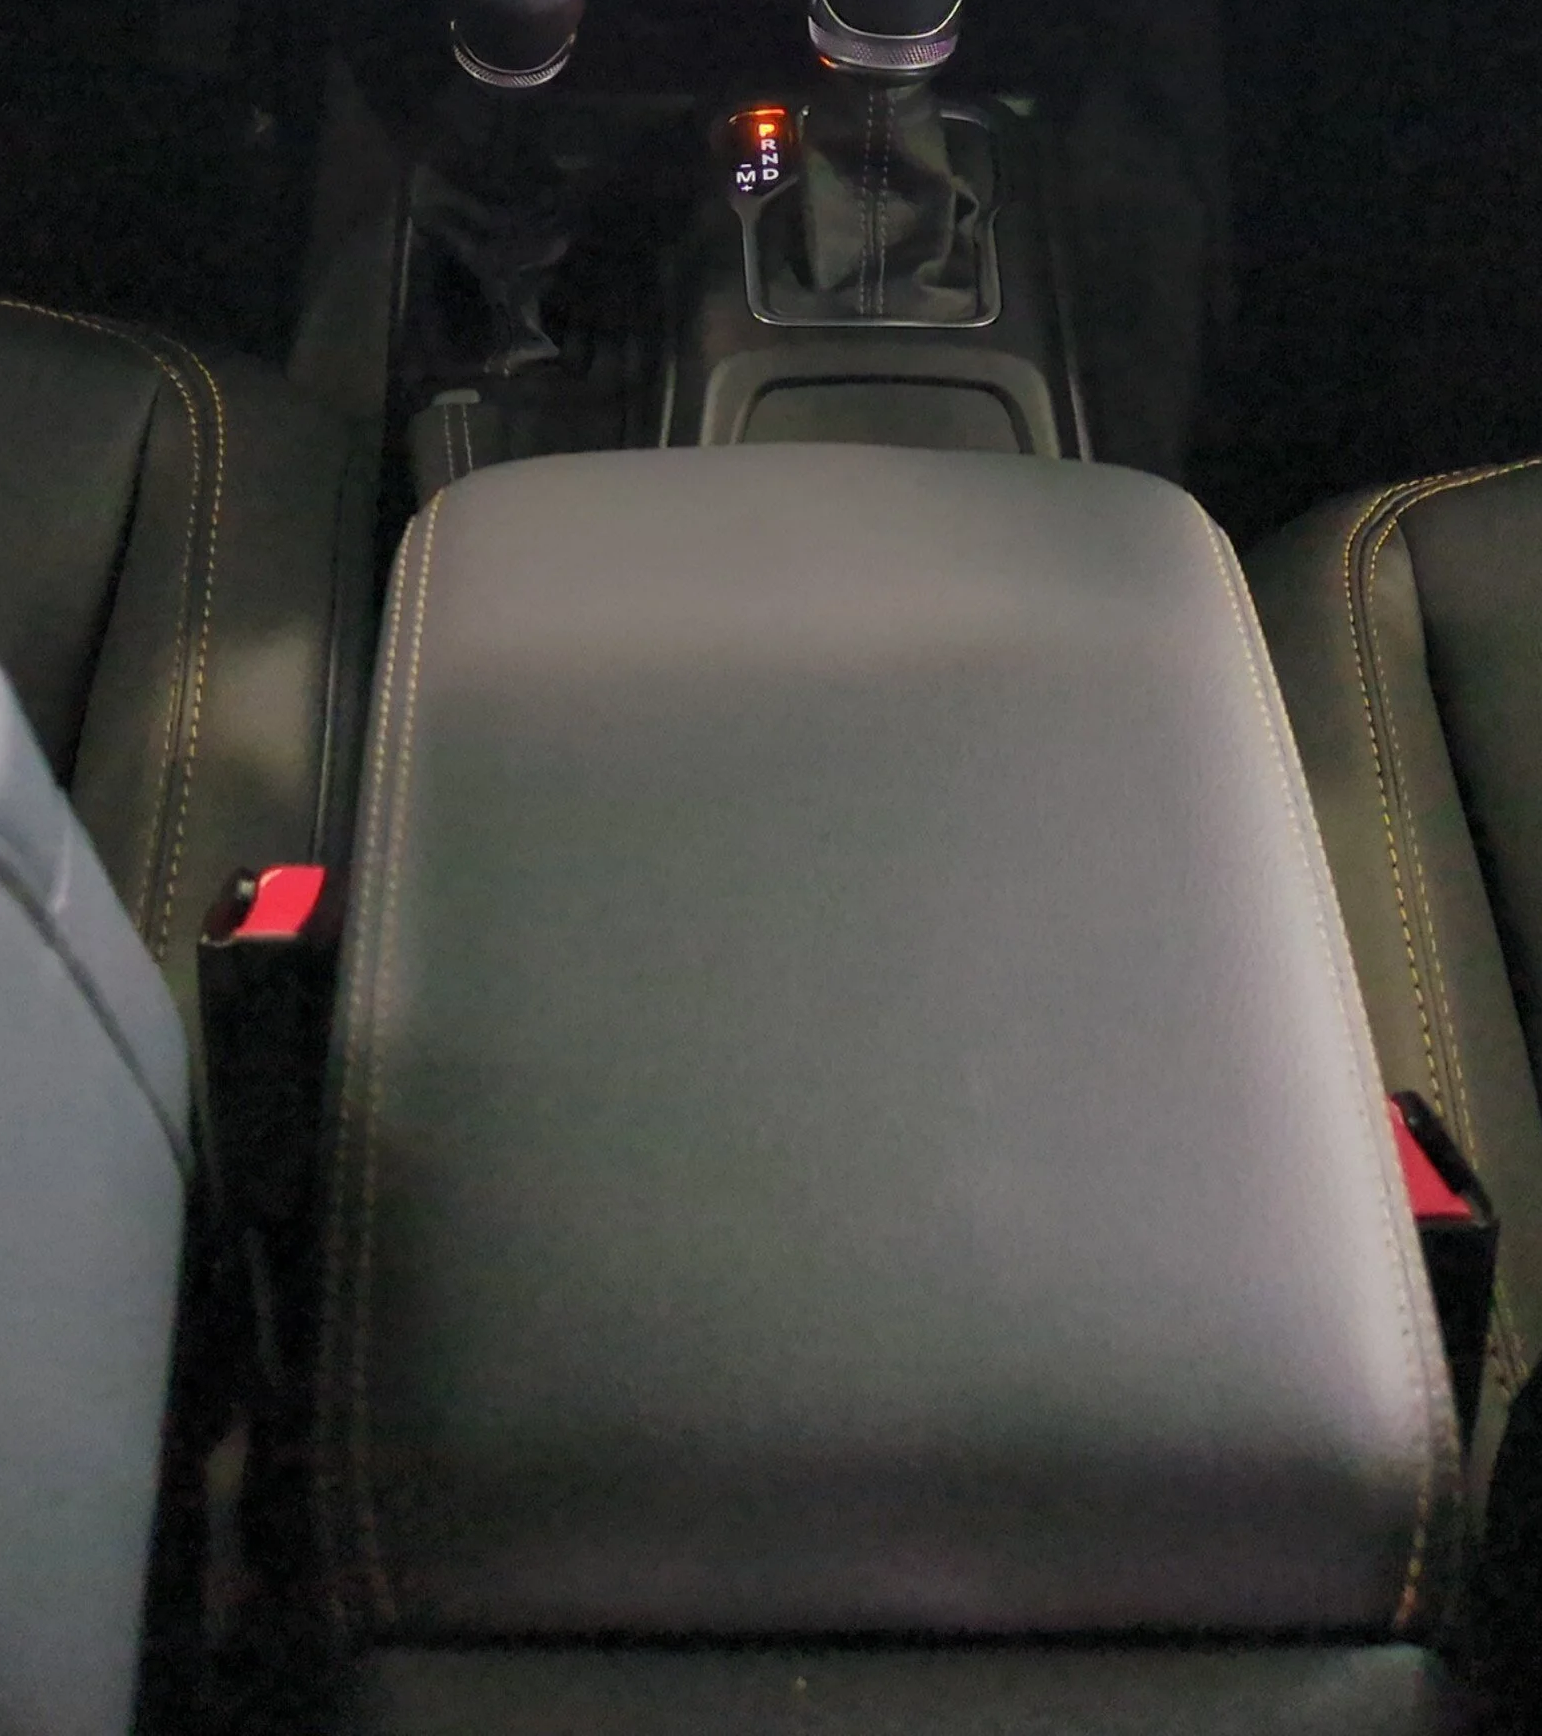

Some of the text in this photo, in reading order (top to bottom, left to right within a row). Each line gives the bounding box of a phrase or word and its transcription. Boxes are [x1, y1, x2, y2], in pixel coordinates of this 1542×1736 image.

[758, 123, 776, 138] P
[760, 138, 777, 151] R
[761, 152, 779, 166] N
[735, 169, 757, 184] M
[762, 168, 780, 181] D
